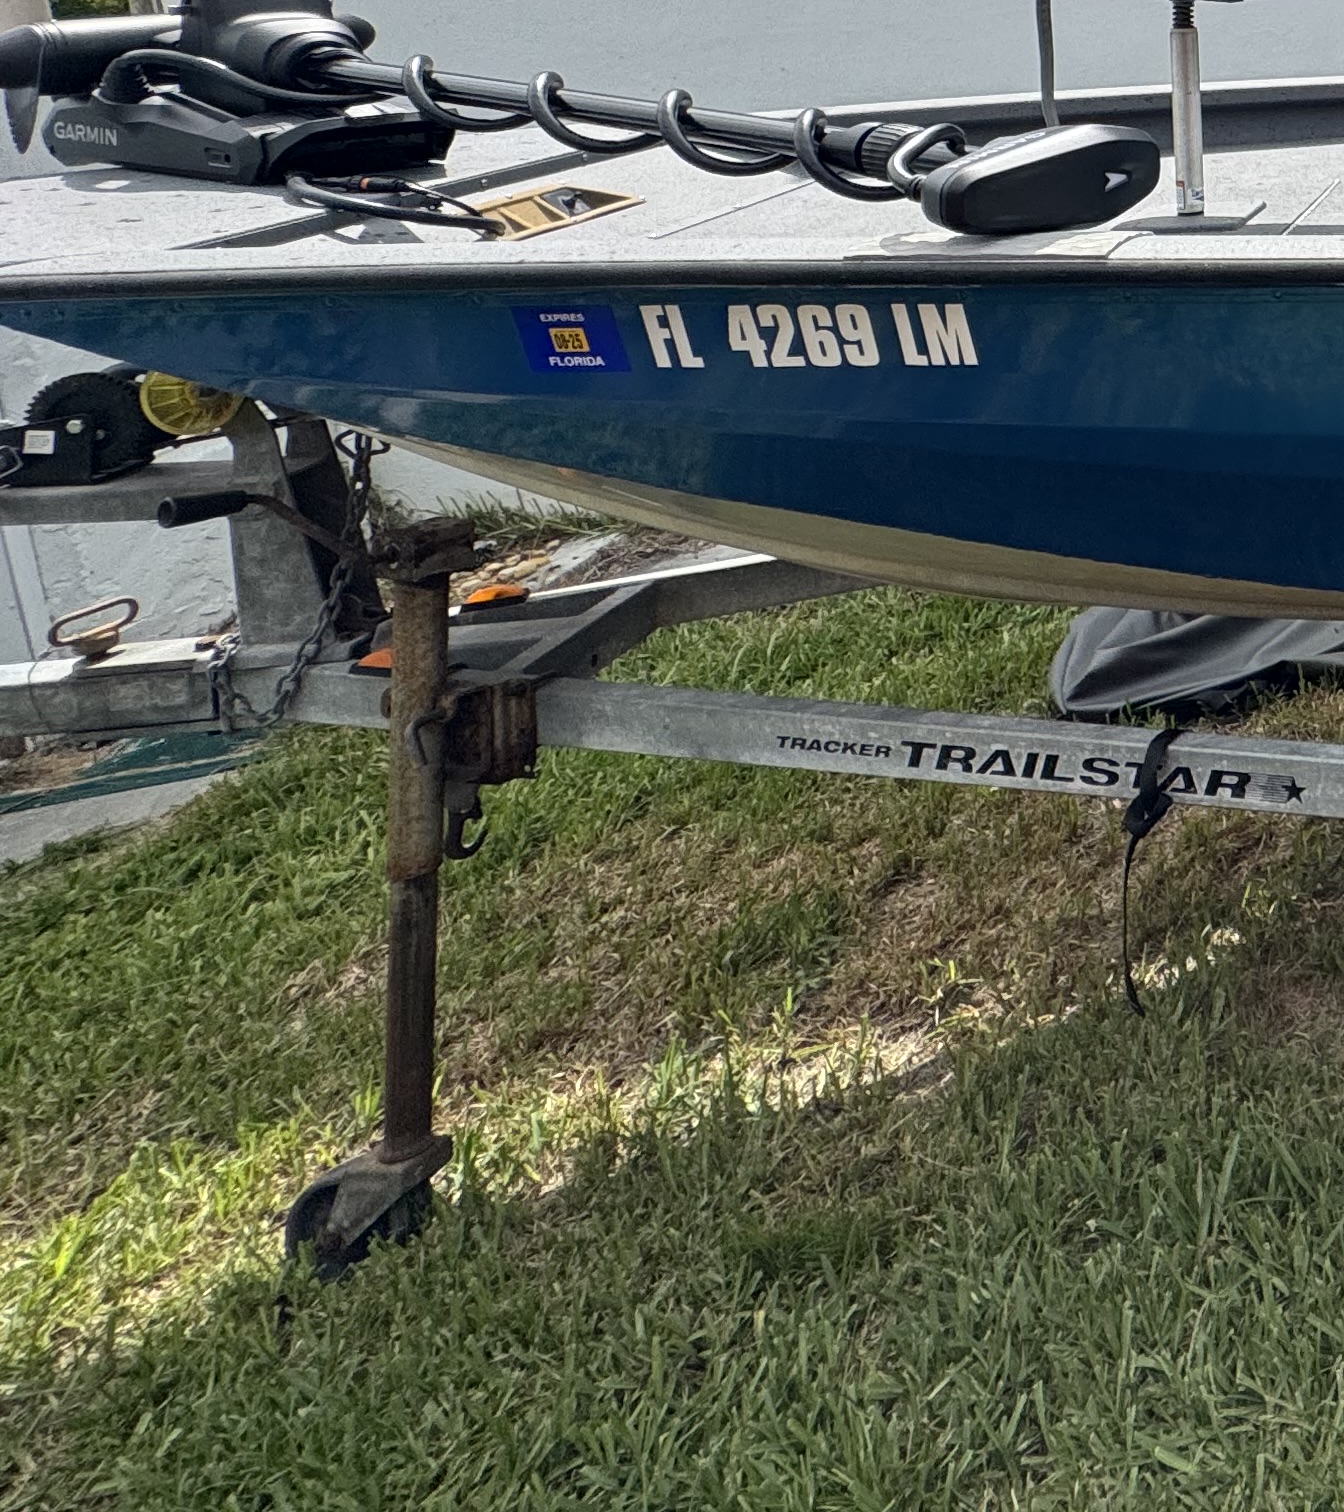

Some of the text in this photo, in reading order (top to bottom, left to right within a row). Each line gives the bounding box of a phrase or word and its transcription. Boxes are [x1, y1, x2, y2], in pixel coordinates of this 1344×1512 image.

[53, 121, 119, 146] GARMIN
[539, 313, 585, 323] EXPIRES
[639, 303, 979, 368] FL 4269 LM
[548, 356, 606, 368] FLORIDA
[776, 735, 892, 758] TRACKER
